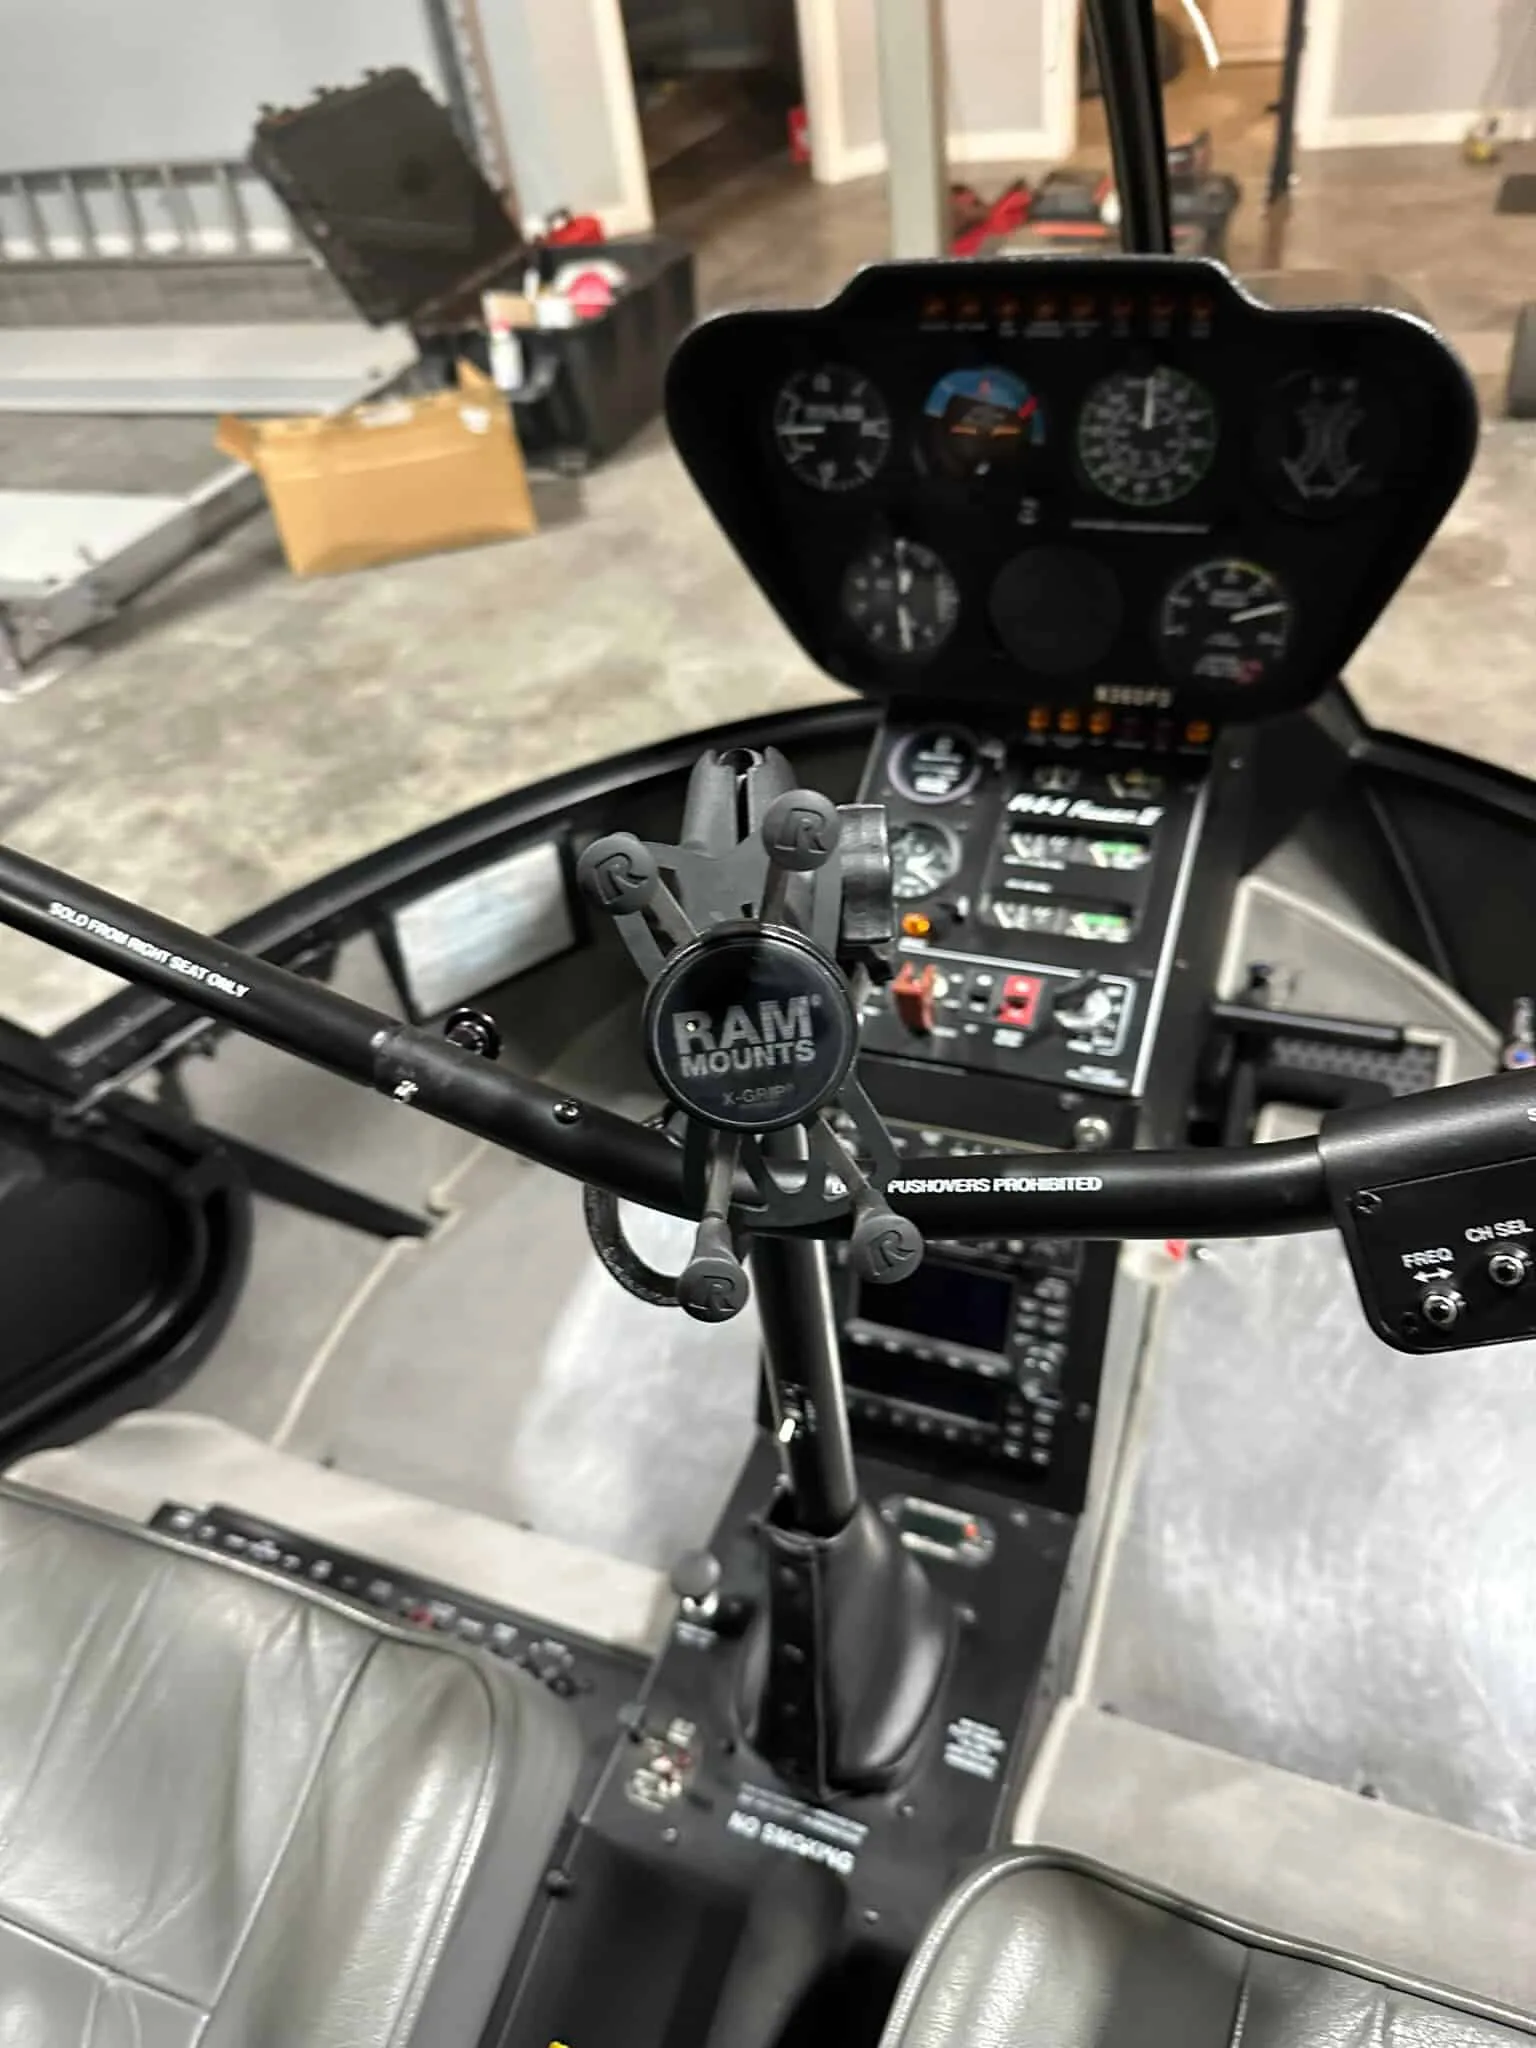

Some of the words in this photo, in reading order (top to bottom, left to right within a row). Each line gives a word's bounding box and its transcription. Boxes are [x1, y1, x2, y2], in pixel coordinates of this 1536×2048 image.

[48, 901, 90, 928] SOLO
[87, 918, 130, 945] FROM
[127, 936, 174, 964] RIGHT
[168, 955, 212, 981] SEAT
[205, 972, 250, 998] ONLY
[680, 1039, 816, 1078] MOUNTS
[887, 1178, 991, 1194] PUSHOVERS
[993, 1176, 1104, 1193] PROHIBITED
[1465, 1225, 1495, 1243] CH
[1494, 1219, 1534, 1238] SEL
[1401, 1247, 1455, 1269] FREQ
[727, 1809, 761, 1838] NO
[761, 1821, 856, 1874] SMOKING
